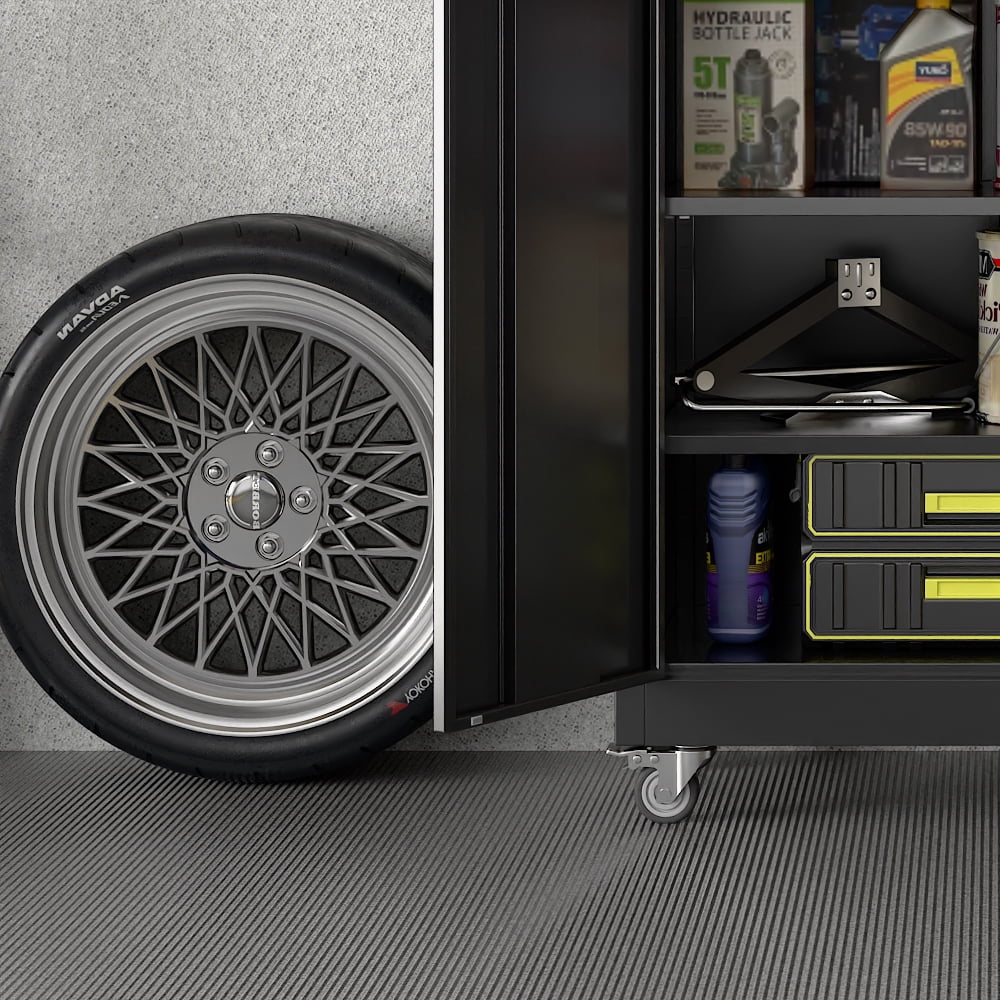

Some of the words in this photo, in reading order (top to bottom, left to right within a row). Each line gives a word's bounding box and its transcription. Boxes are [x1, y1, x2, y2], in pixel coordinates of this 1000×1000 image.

[694, 10, 792, 25] HYDRAULIC
[693, 26, 750, 40] BOTTLE
[756, 26, 791, 41] JACK
[694, 56, 731, 90] 5T
